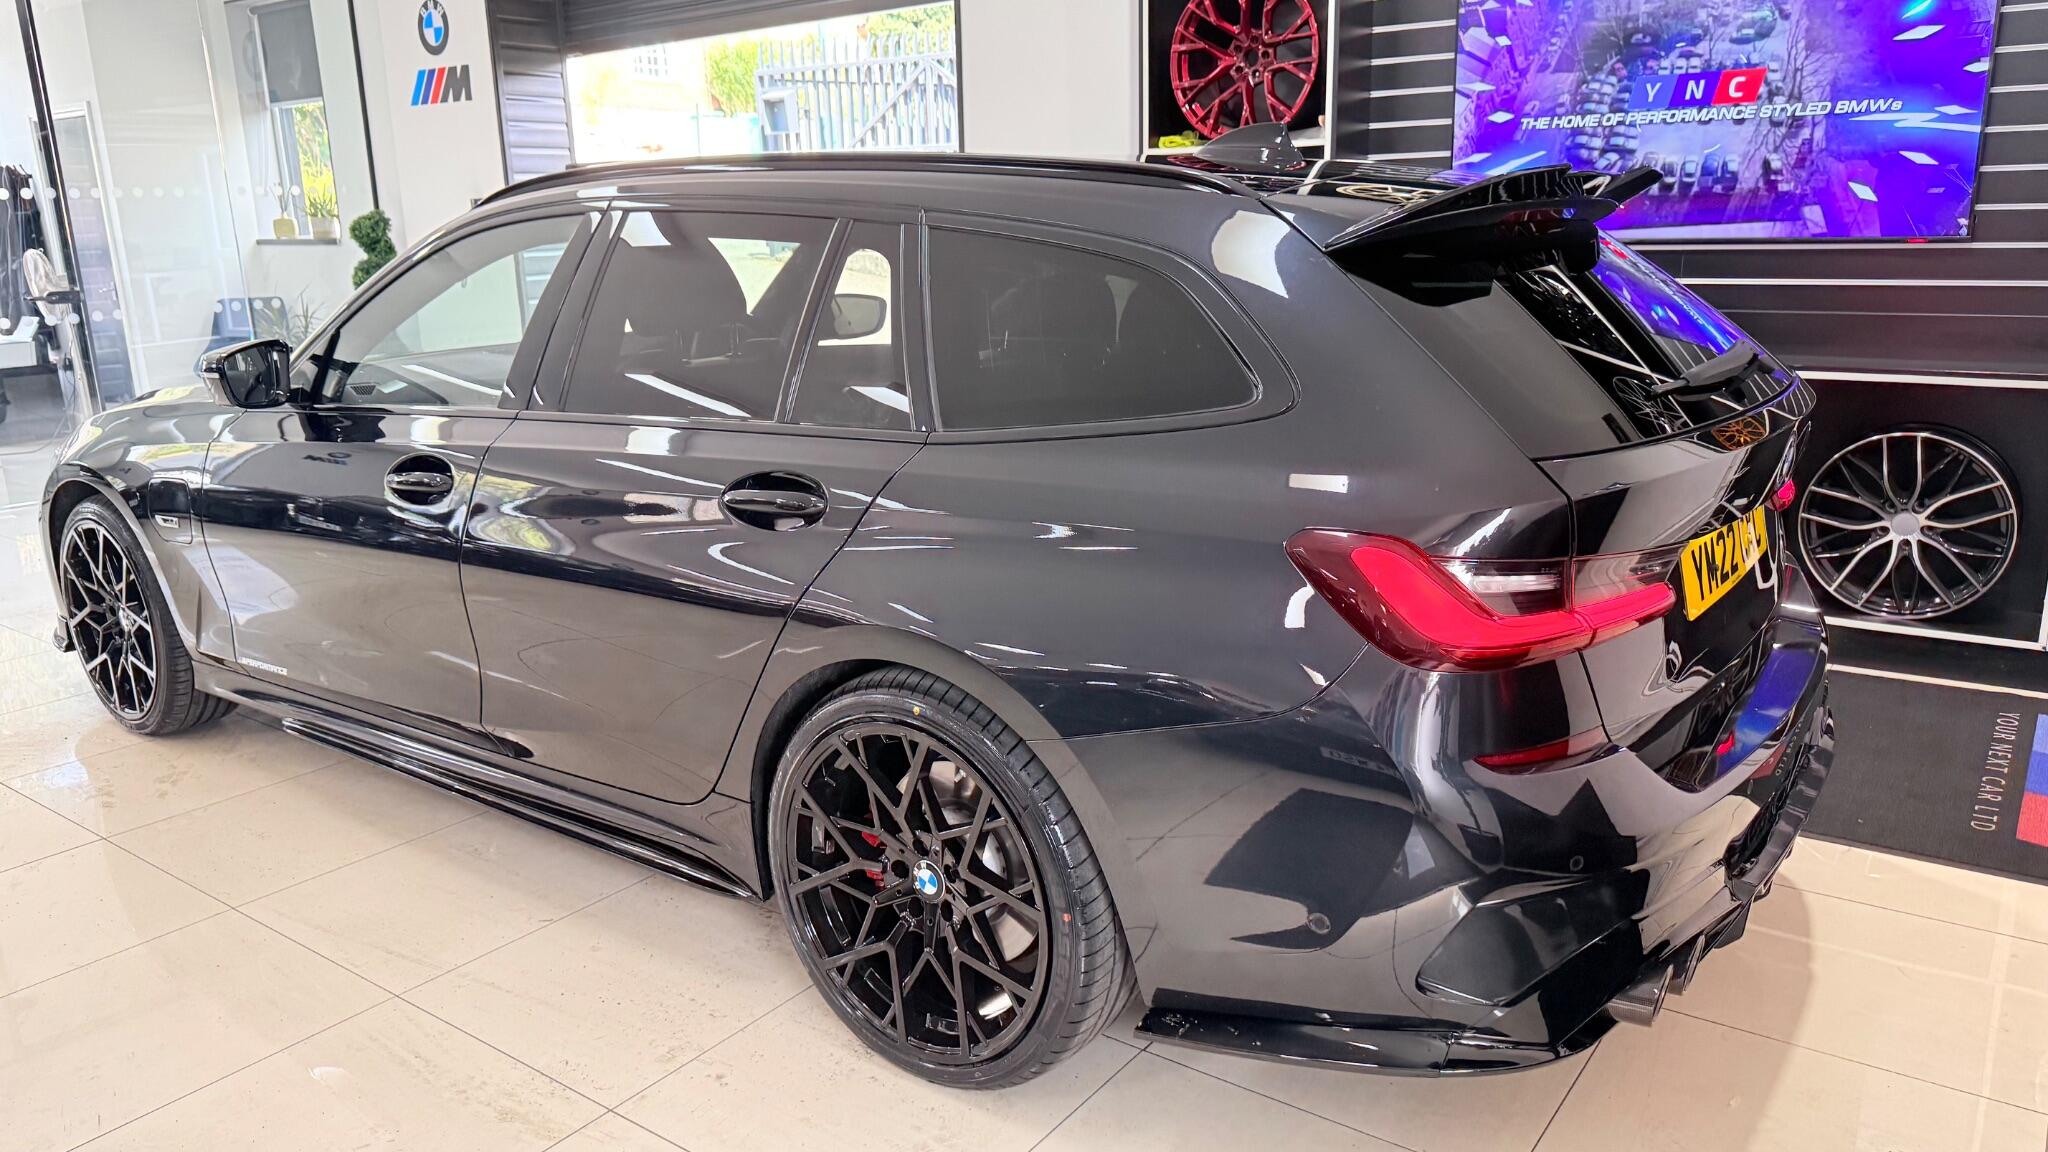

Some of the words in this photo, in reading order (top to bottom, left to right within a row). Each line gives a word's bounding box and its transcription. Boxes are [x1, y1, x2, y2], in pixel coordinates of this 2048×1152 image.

[420, 0, 445, 16] BMW
[1520, 116, 1550, 130] THE
[1551, 113, 1599, 129] HOME
[1602, 111, 1626, 126] OF
[1625, 105, 1757, 125] PERFORMANCE
[1759, 101, 1831, 117] STYLED
[1834, 98, 1903, 115] BMWs
[1691, 523, 1739, 602] YM22
[1993, 711, 2021, 741] YOUR
[1985, 742, 2013, 774] NEXT
[1977, 776, 2006, 802] CAR
[1970, 804, 2000, 831] LTD
